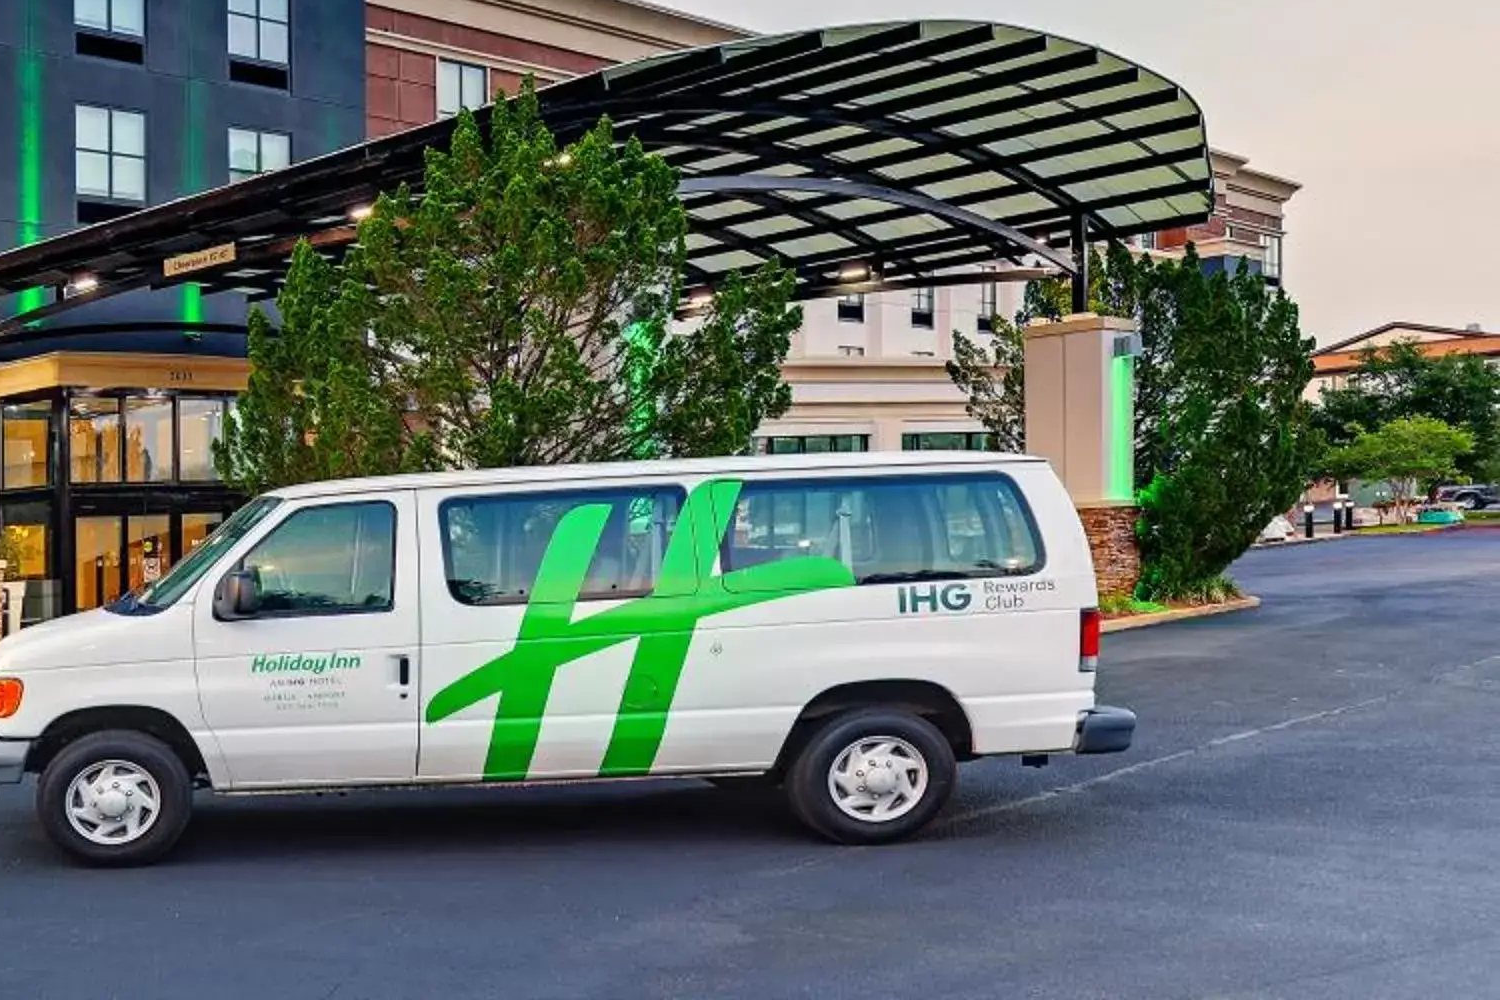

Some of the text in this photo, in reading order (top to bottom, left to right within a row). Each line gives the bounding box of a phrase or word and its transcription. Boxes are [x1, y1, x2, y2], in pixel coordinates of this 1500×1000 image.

[983, 579, 1056, 594] Rewards
[897, 583, 972, 614] IHG
[985, 594, 1025, 610] Club
[251, 652, 362, 675] Holiday Inn
